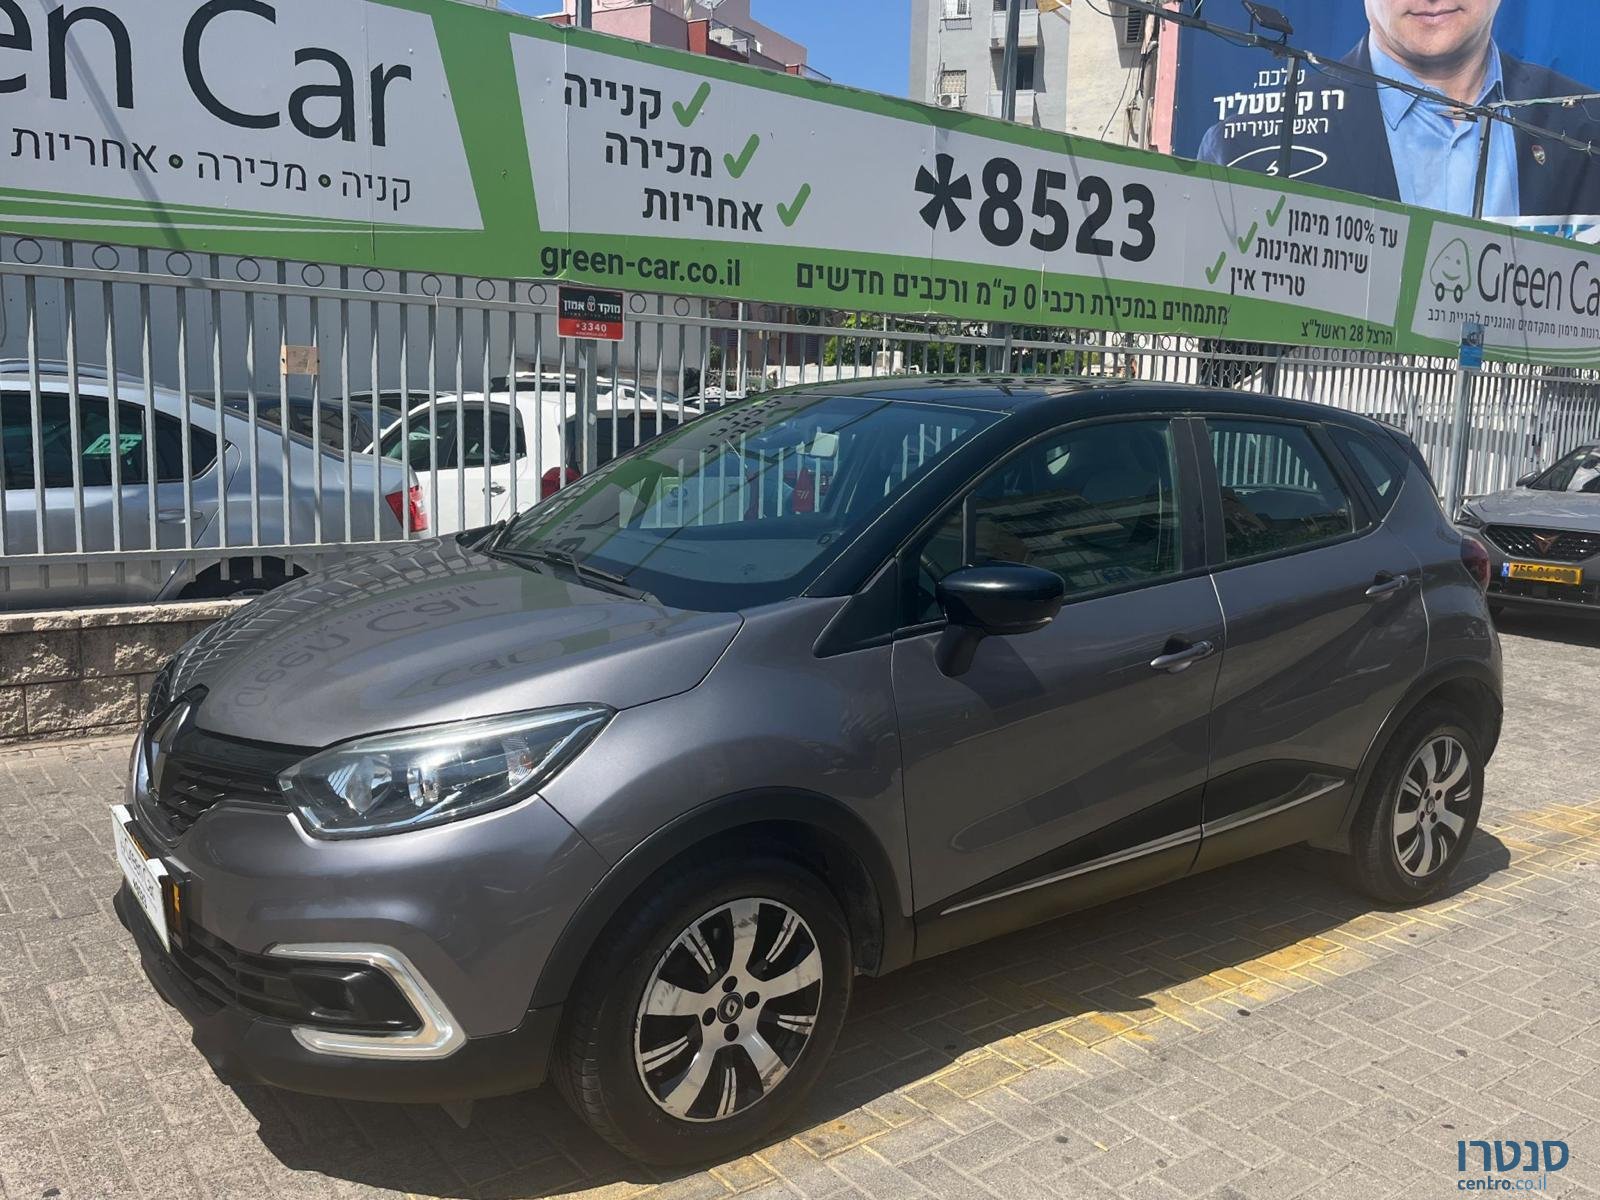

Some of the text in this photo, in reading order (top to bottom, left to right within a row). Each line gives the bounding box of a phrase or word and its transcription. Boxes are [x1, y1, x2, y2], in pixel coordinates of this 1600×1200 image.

[183, 0, 412, 146] Car
[564, 72, 662, 129] קנייה
[1320, 89, 1345, 111] רז
[1292, 117, 1329, 135] ראש
[11, 127, 411, 211] קניה מכירה אחריות
[605, 131, 712, 178] מכירה
[642, 187, 763, 232] אחריות
[1288, 208, 1398, 249] עד 100% מימון
[540, 245, 741, 287] green-car.co.il
[1255, 237, 1368, 274] שירות ואמינות
[796, 262, 884, 295] חדשים
[893, 272, 968, 303] ורכבים
[1230, 266, 1305, 297] טרייד אין
[1477, 243, 1563, 312] Green
[564, 300, 621, 315] מוקד אמון
[1023, 283, 1037, 311] 0
[1042, 289, 1086, 315] רכבי
[1091, 294, 1157, 321] במכירת
[1162, 300, 1229, 326] מתמחים
[1428, 308, 1446, 322] רכב
[1349, 326, 1364, 342] 28
[1367, 324, 1393, 346] הרצל
